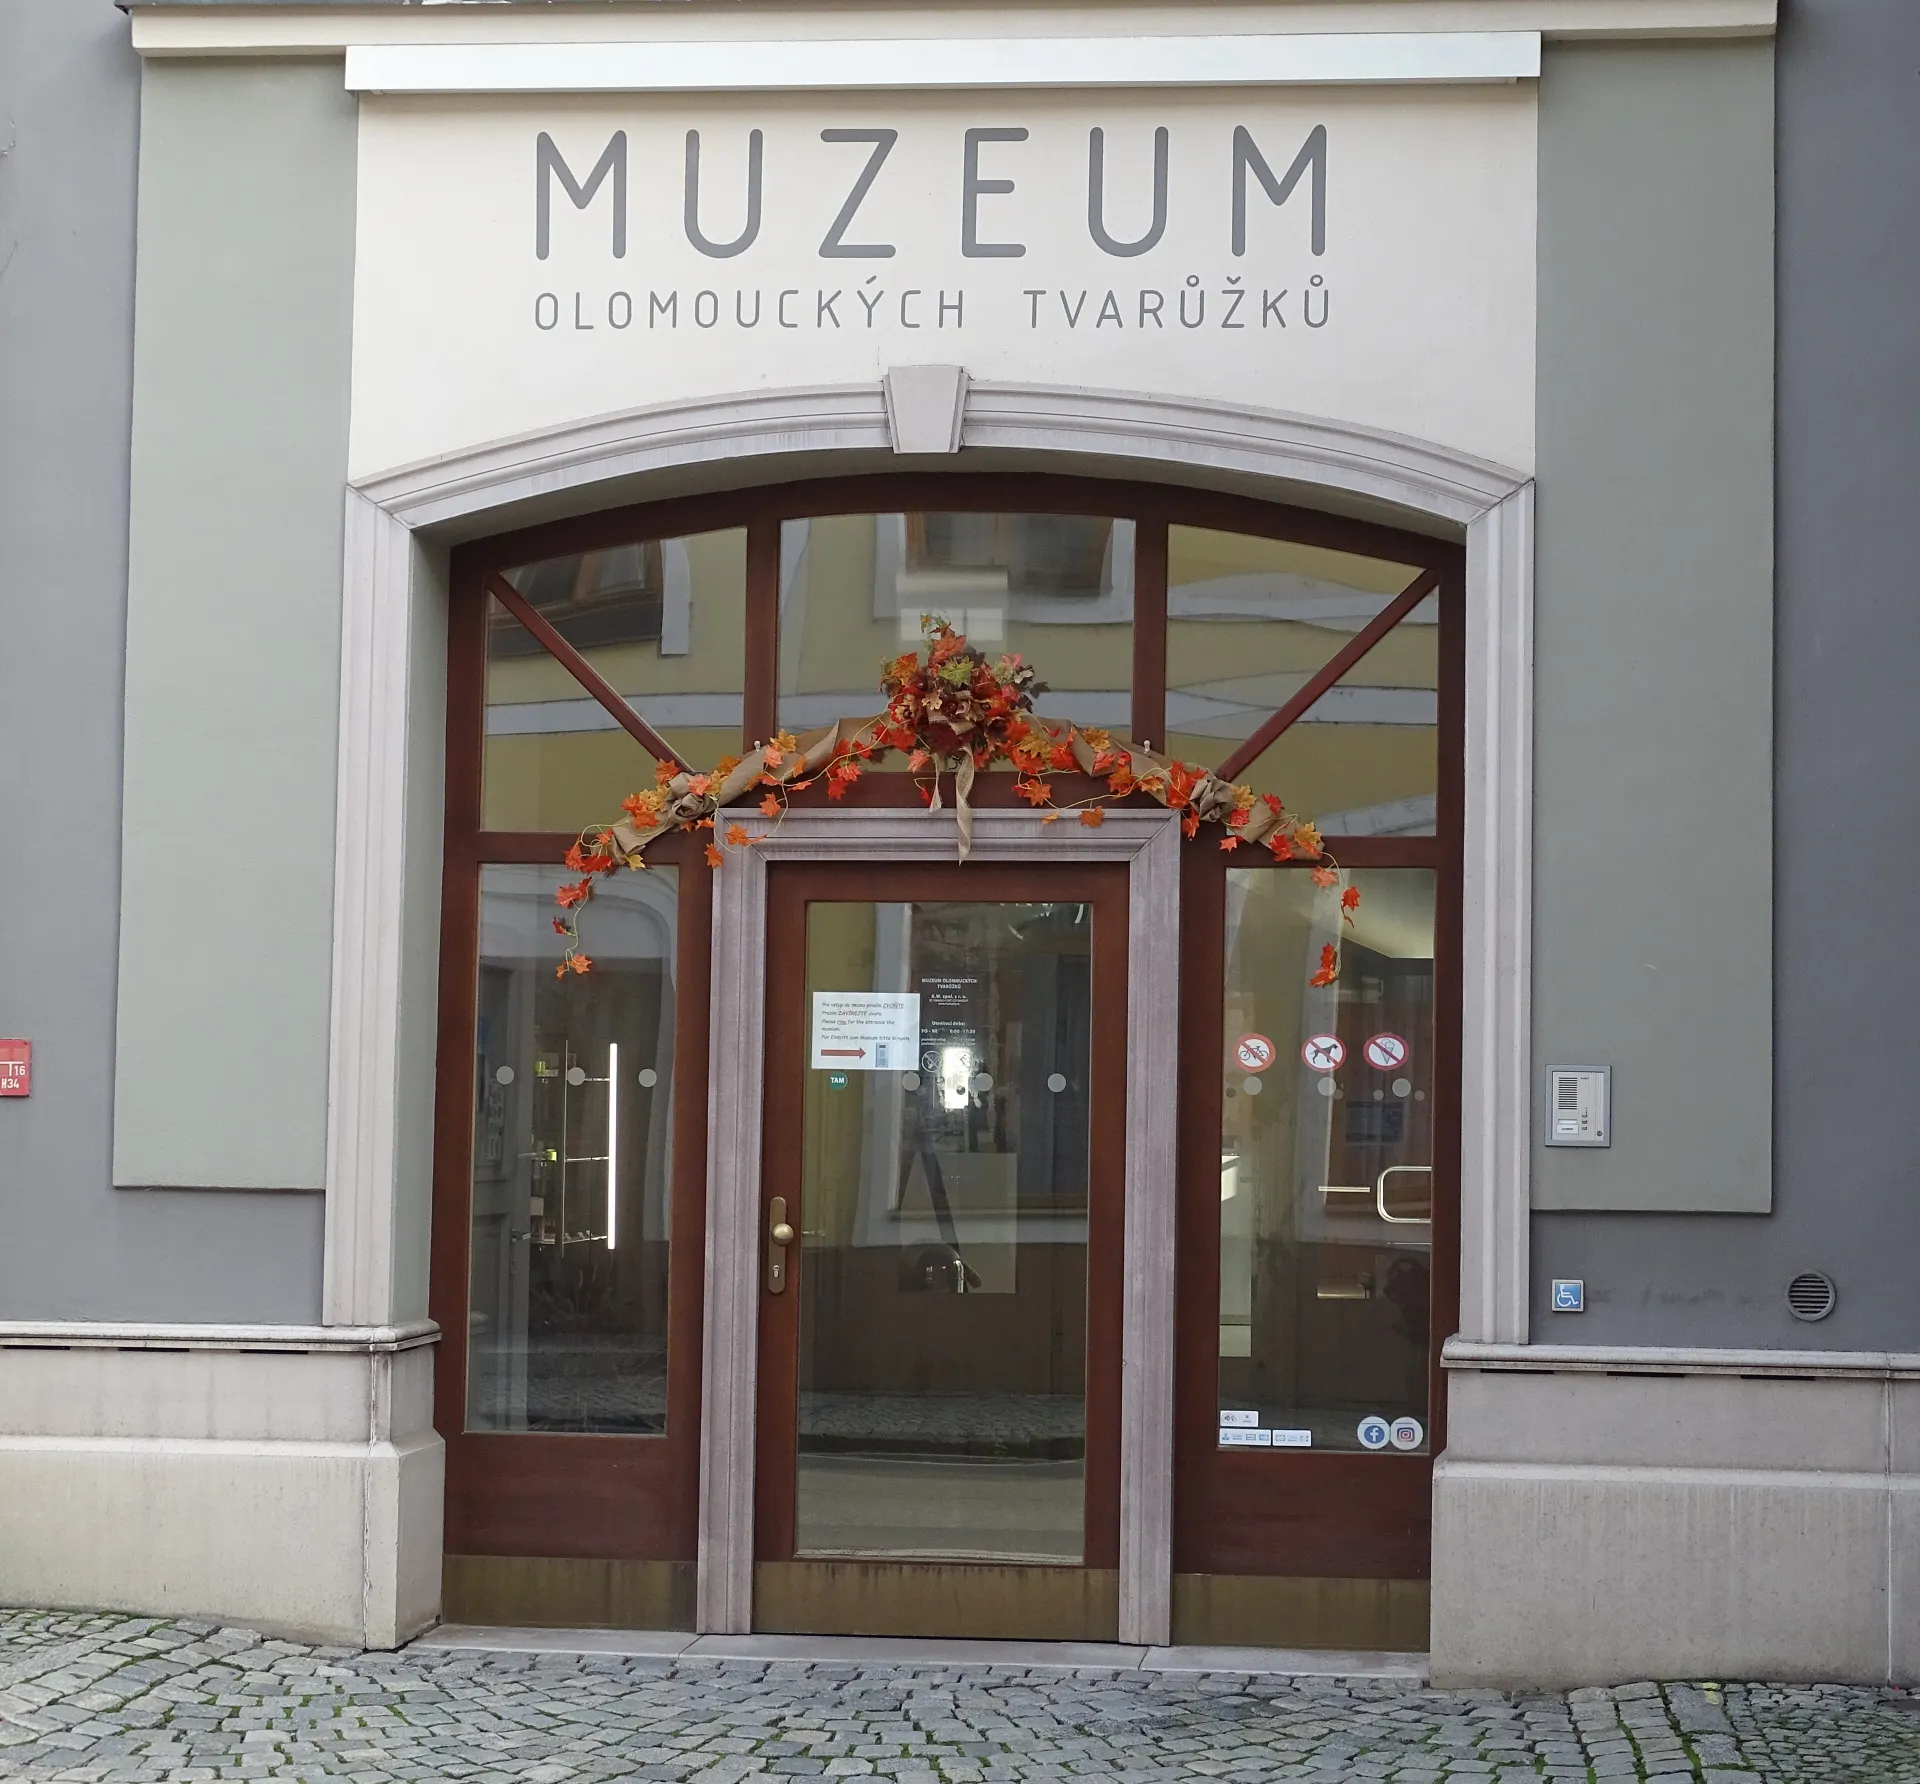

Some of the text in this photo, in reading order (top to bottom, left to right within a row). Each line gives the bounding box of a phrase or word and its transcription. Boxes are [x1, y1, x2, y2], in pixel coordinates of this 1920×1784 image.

[536, 124, 1327, 260] MUZEUM
[536, 275, 1328, 330] OLOMOUCKÝCH TVARŮŽKŮ
